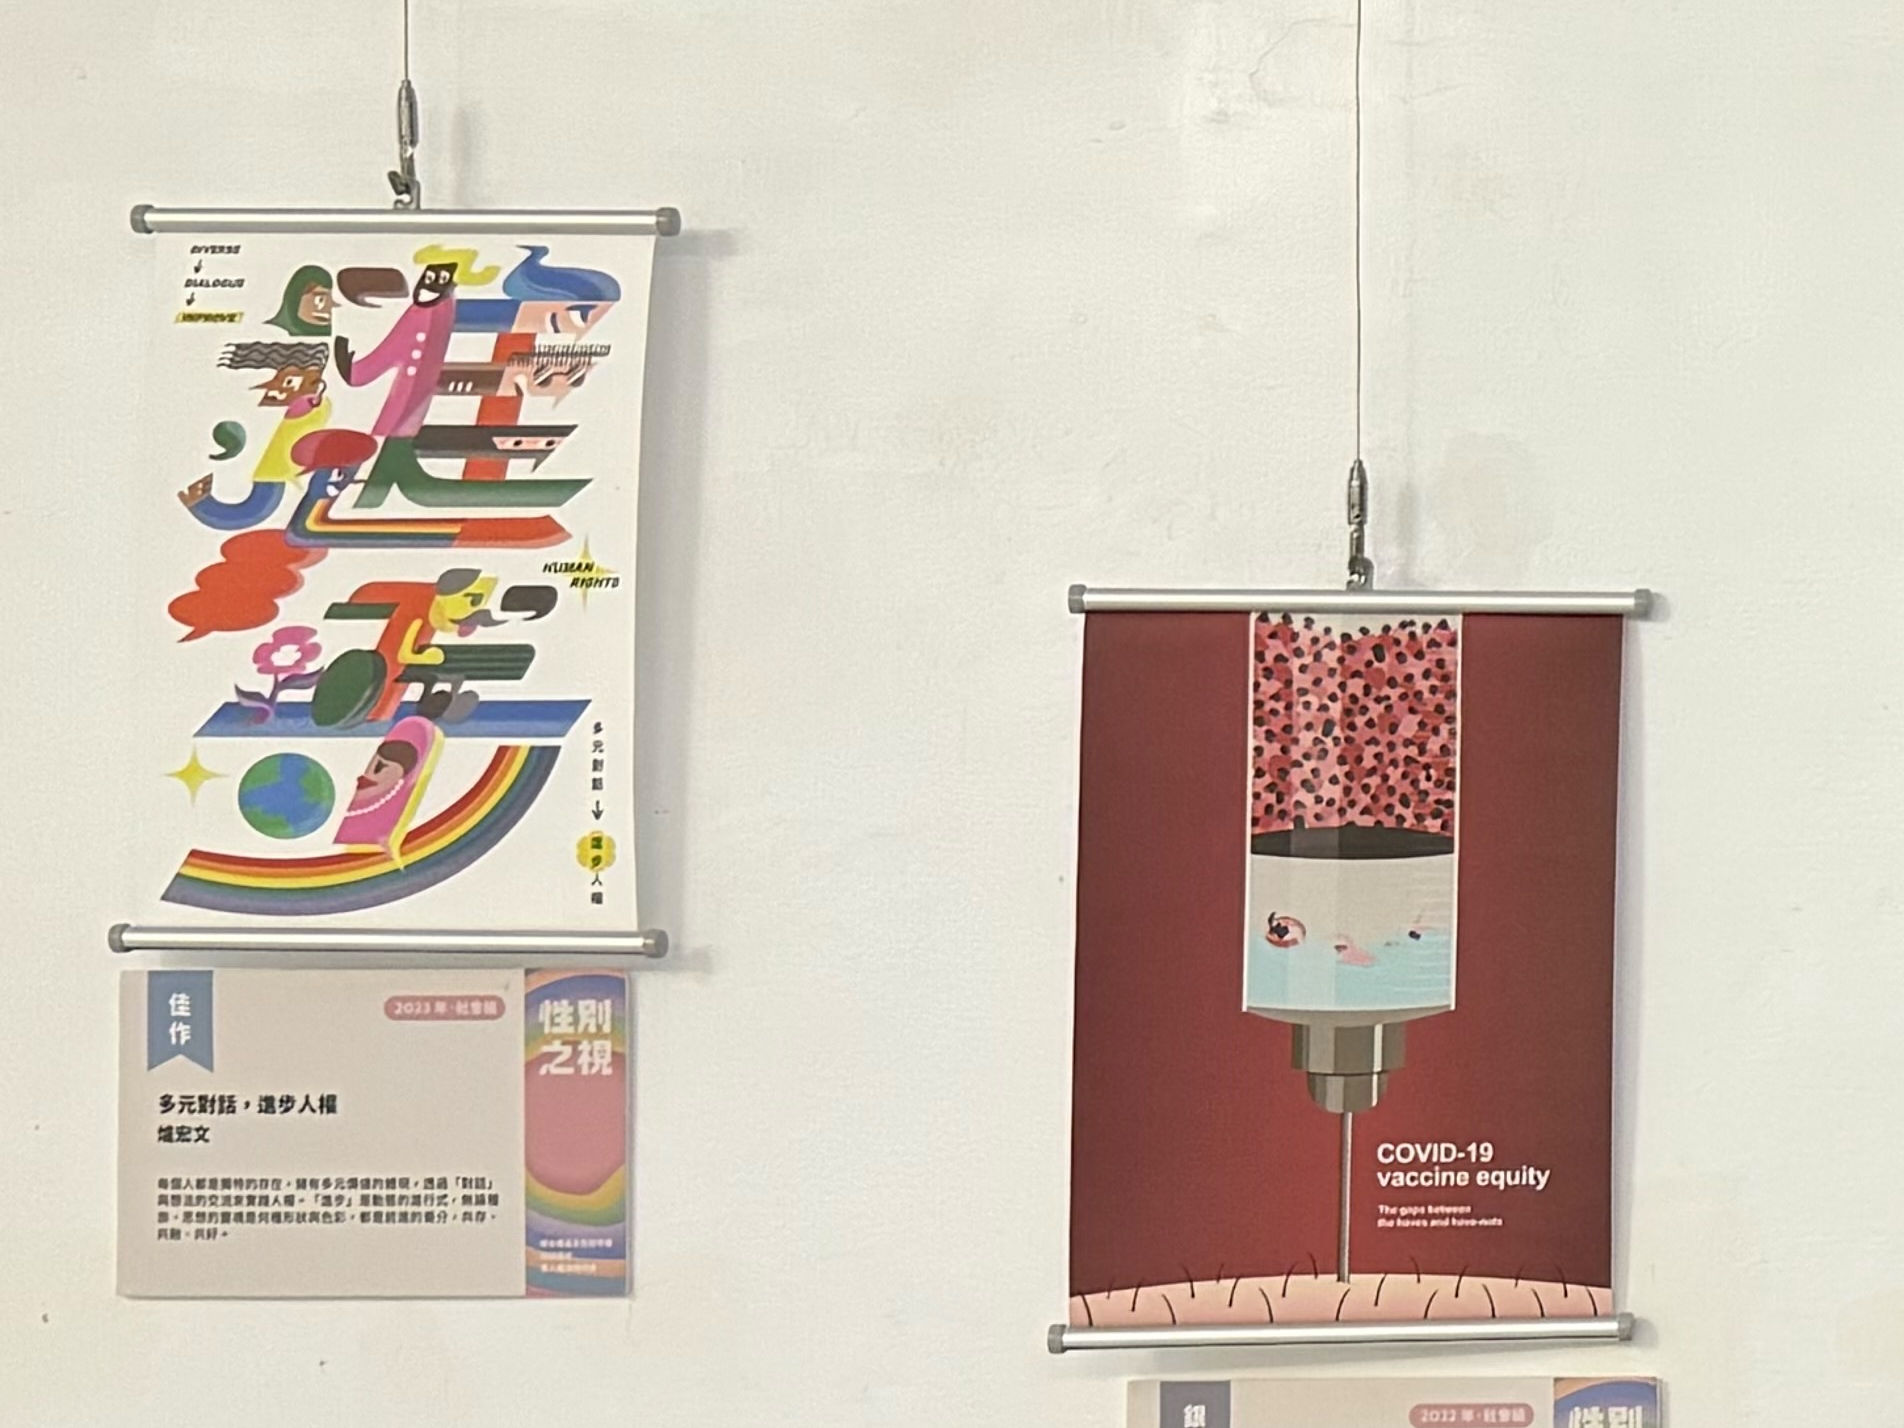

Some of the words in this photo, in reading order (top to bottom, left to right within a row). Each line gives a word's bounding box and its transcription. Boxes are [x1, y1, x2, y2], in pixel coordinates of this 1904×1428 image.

[169, 992, 192, 1046] 佳作
[538, 998, 613, 1035] 性別
[538, 1040, 614, 1076] 之視
[1377, 1142, 1494, 1164] COVID-19
[1377, 1166, 1470, 1188] vaccine
[1476, 1165, 1550, 1191] equity
[1378, 1204, 1397, 1215] The
